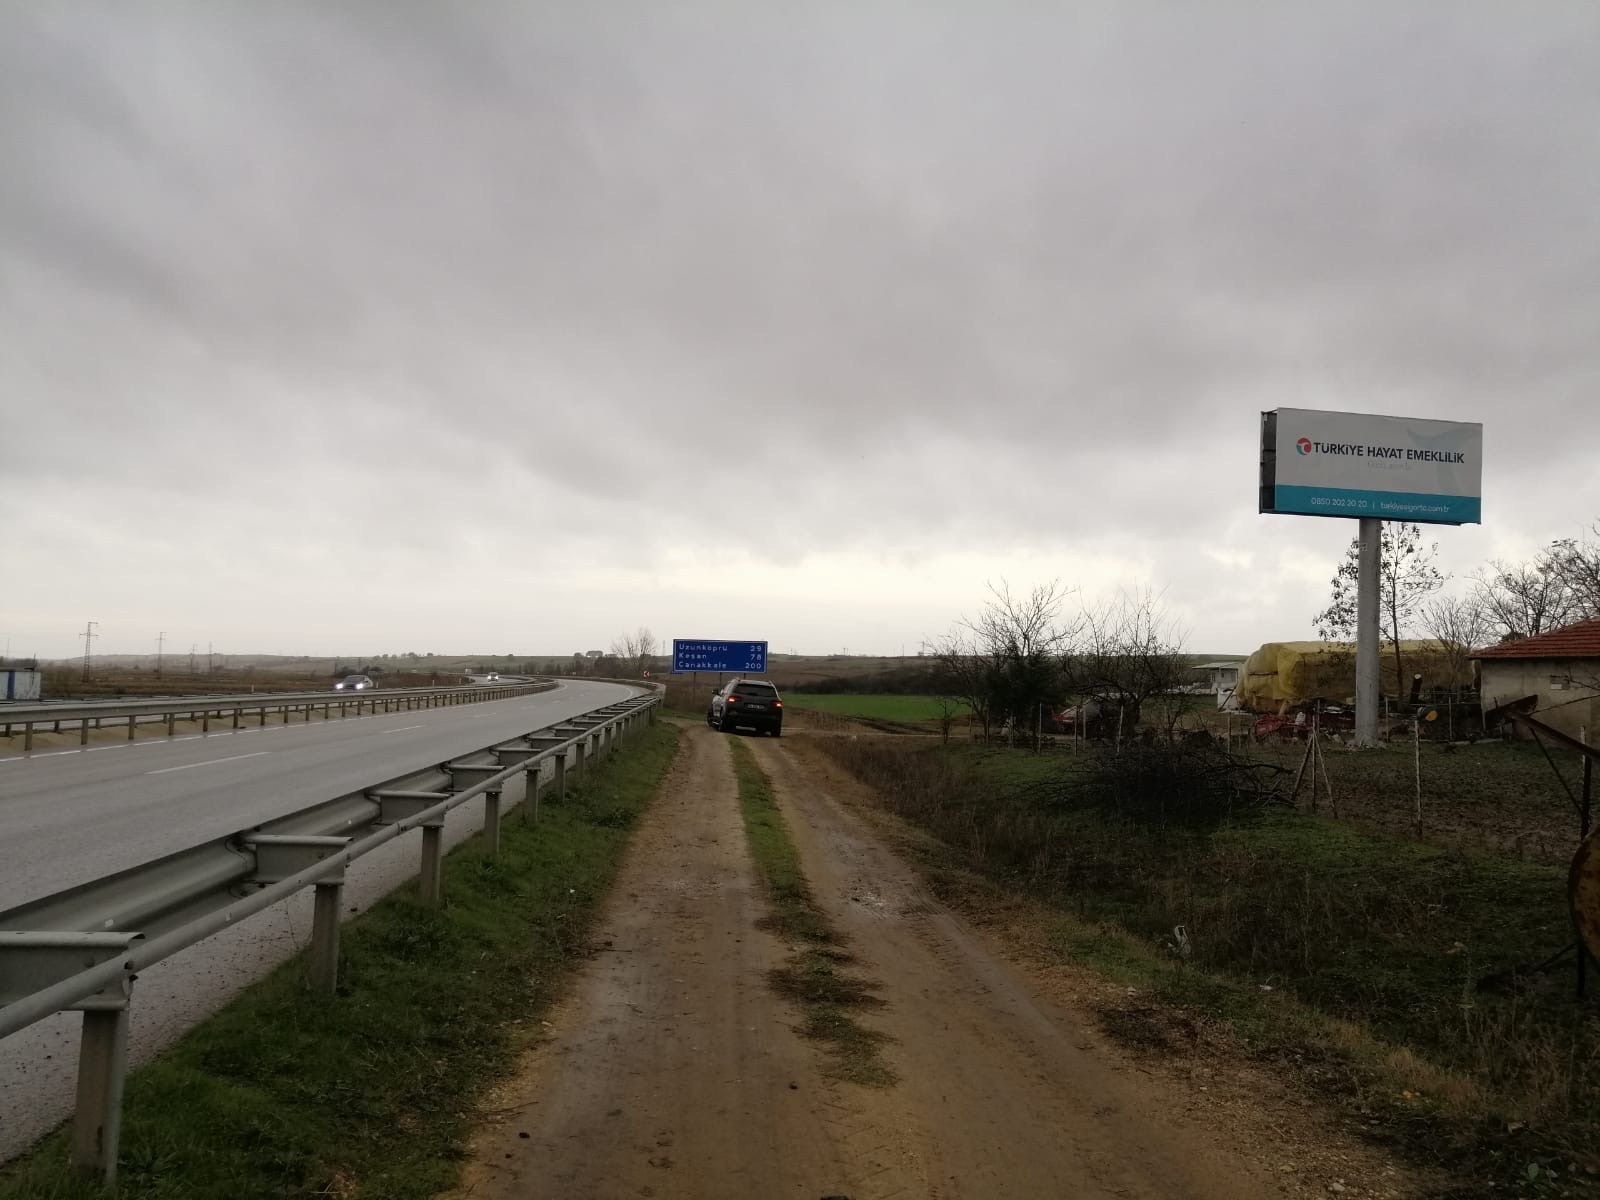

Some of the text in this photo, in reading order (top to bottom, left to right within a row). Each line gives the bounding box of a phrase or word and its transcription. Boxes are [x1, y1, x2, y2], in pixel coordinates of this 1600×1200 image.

[1313, 442, 1465, 464] TÜRKİYE HAYAT EMEKLİLİK
[1332, 498, 1346, 506] 202
[1347, 499, 1357, 507] 20
[1358, 500, 1368, 508] 20
